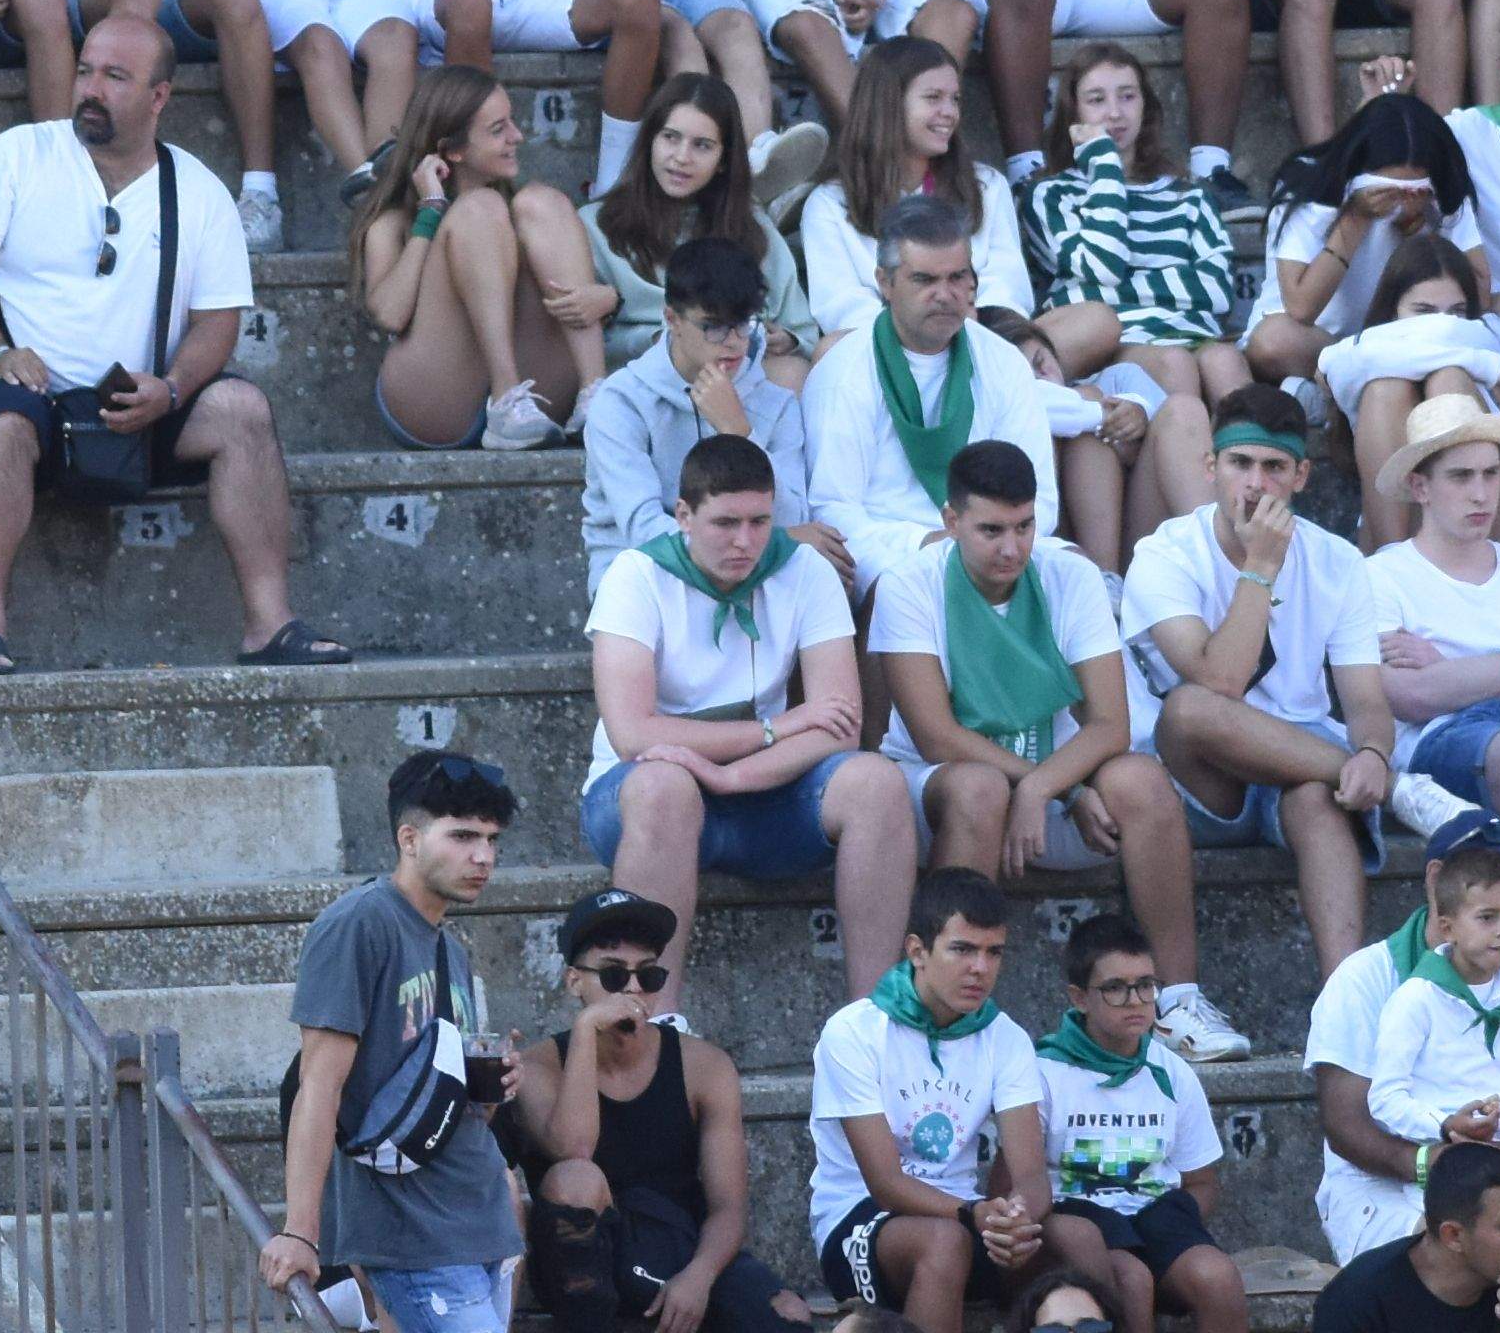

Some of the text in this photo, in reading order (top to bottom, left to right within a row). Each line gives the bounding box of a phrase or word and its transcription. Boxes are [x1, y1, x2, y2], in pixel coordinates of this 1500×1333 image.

[542, 95, 565, 123] 6
[244, 313, 268, 342] 4
[385, 503, 409, 532] 4
[417, 710, 435, 741] 1
[813, 913, 838, 943] 2
